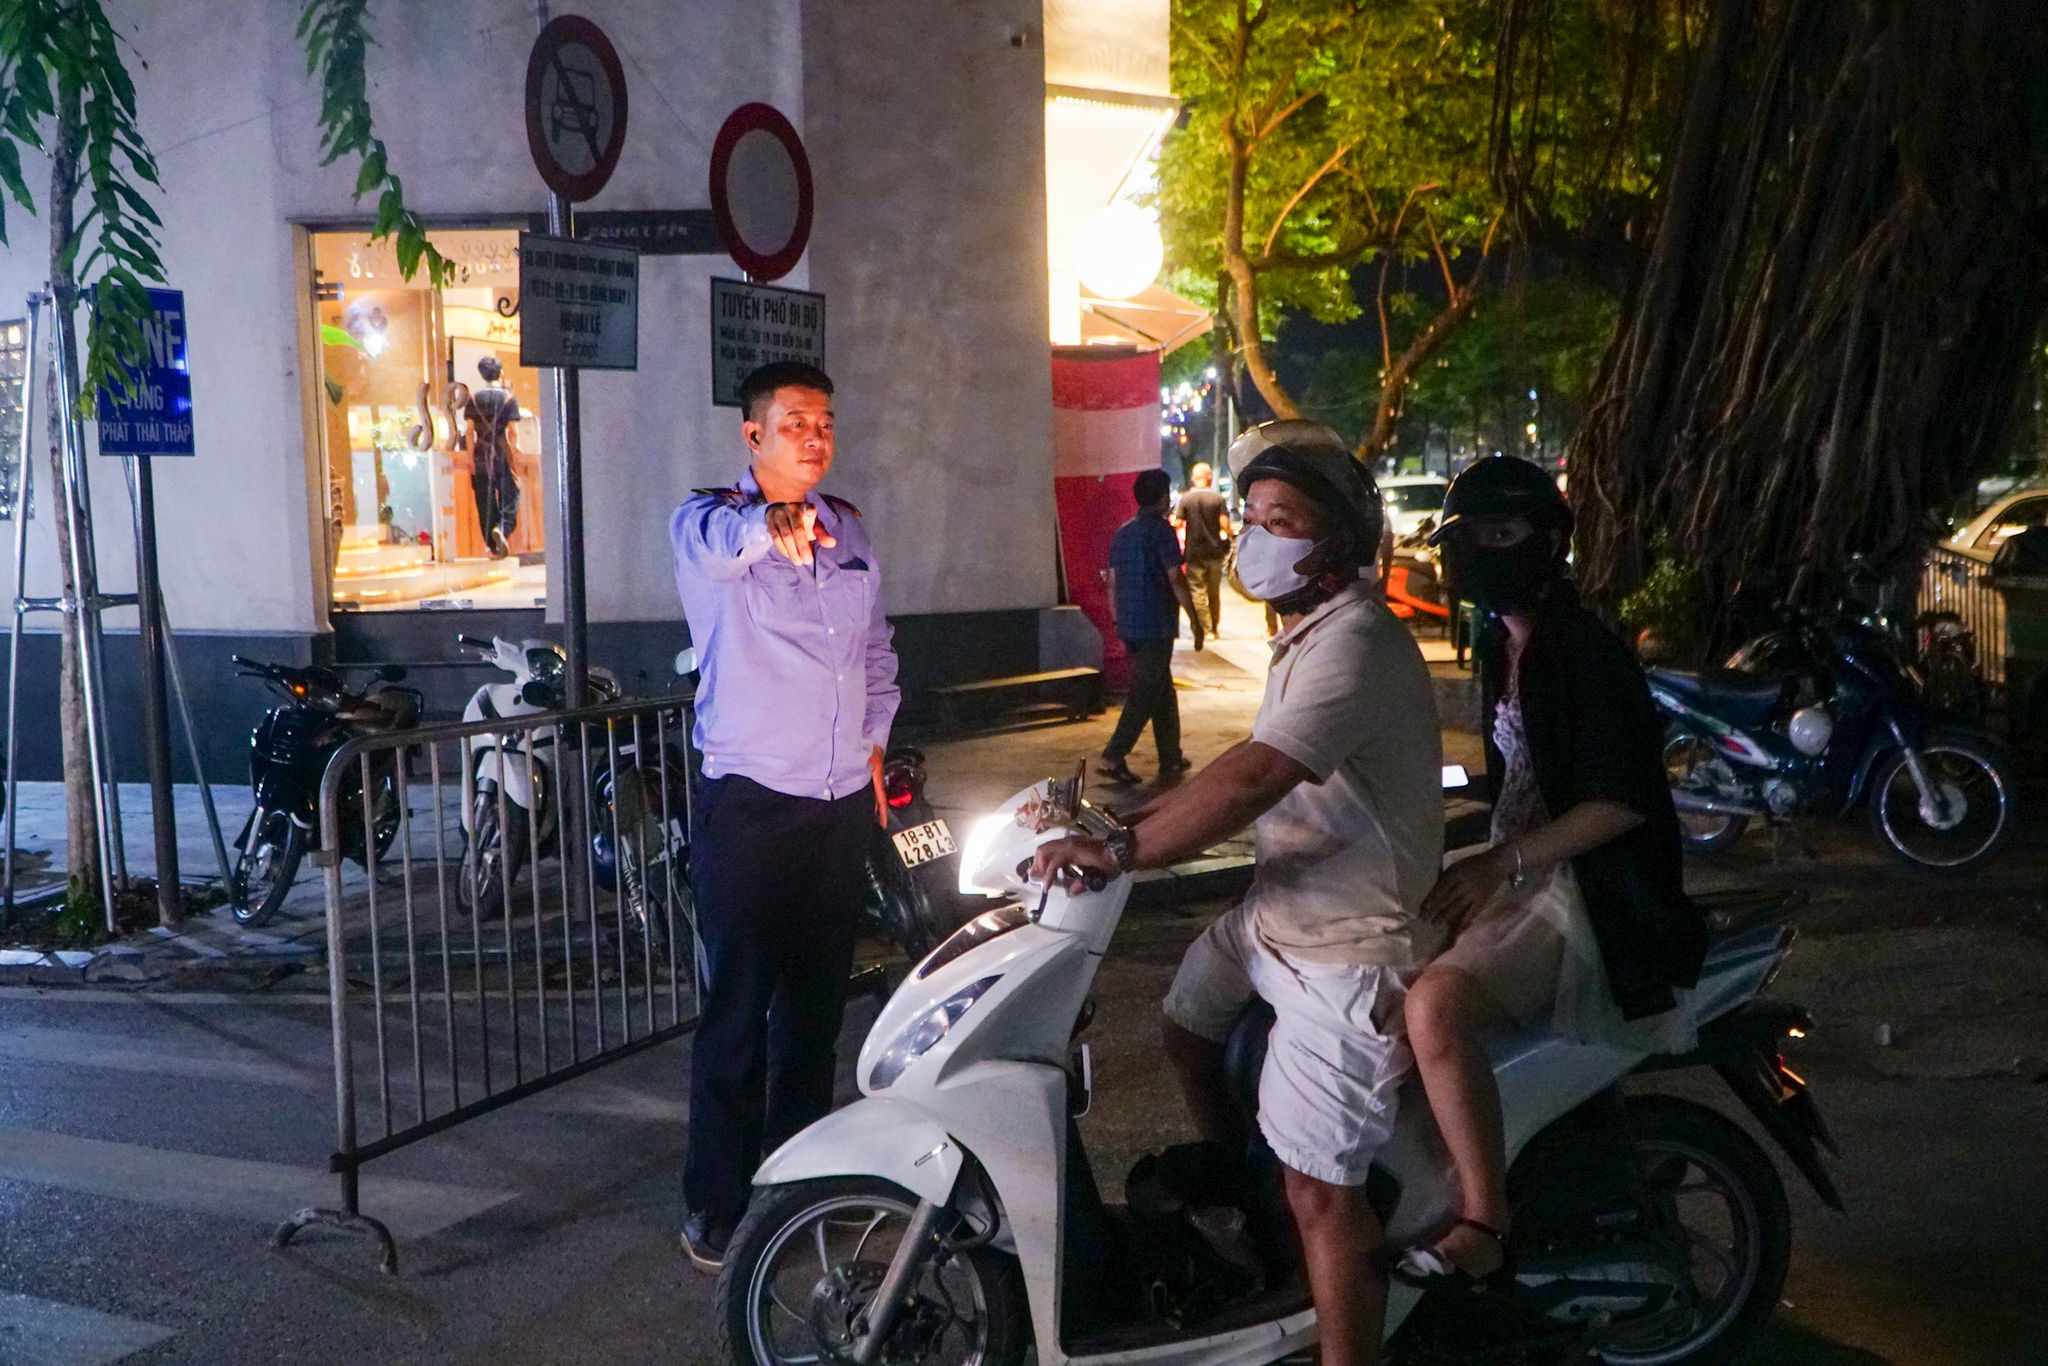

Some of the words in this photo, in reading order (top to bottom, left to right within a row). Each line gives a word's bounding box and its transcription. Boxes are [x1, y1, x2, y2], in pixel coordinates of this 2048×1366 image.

[721, 290, 760, 321] TUYẾN
[763, 295, 787, 325] PHỐ
[790, 303, 800, 327] ĐI
[803, 302, 818, 330] BỘ
[102, 418, 130, 442] PHÁT
[134, 417, 160, 442] THẢI
[163, 418, 191, 443] THẤP
[901, 822, 942, 847] 18-B1
[904, 837, 955, 865] 428.43
